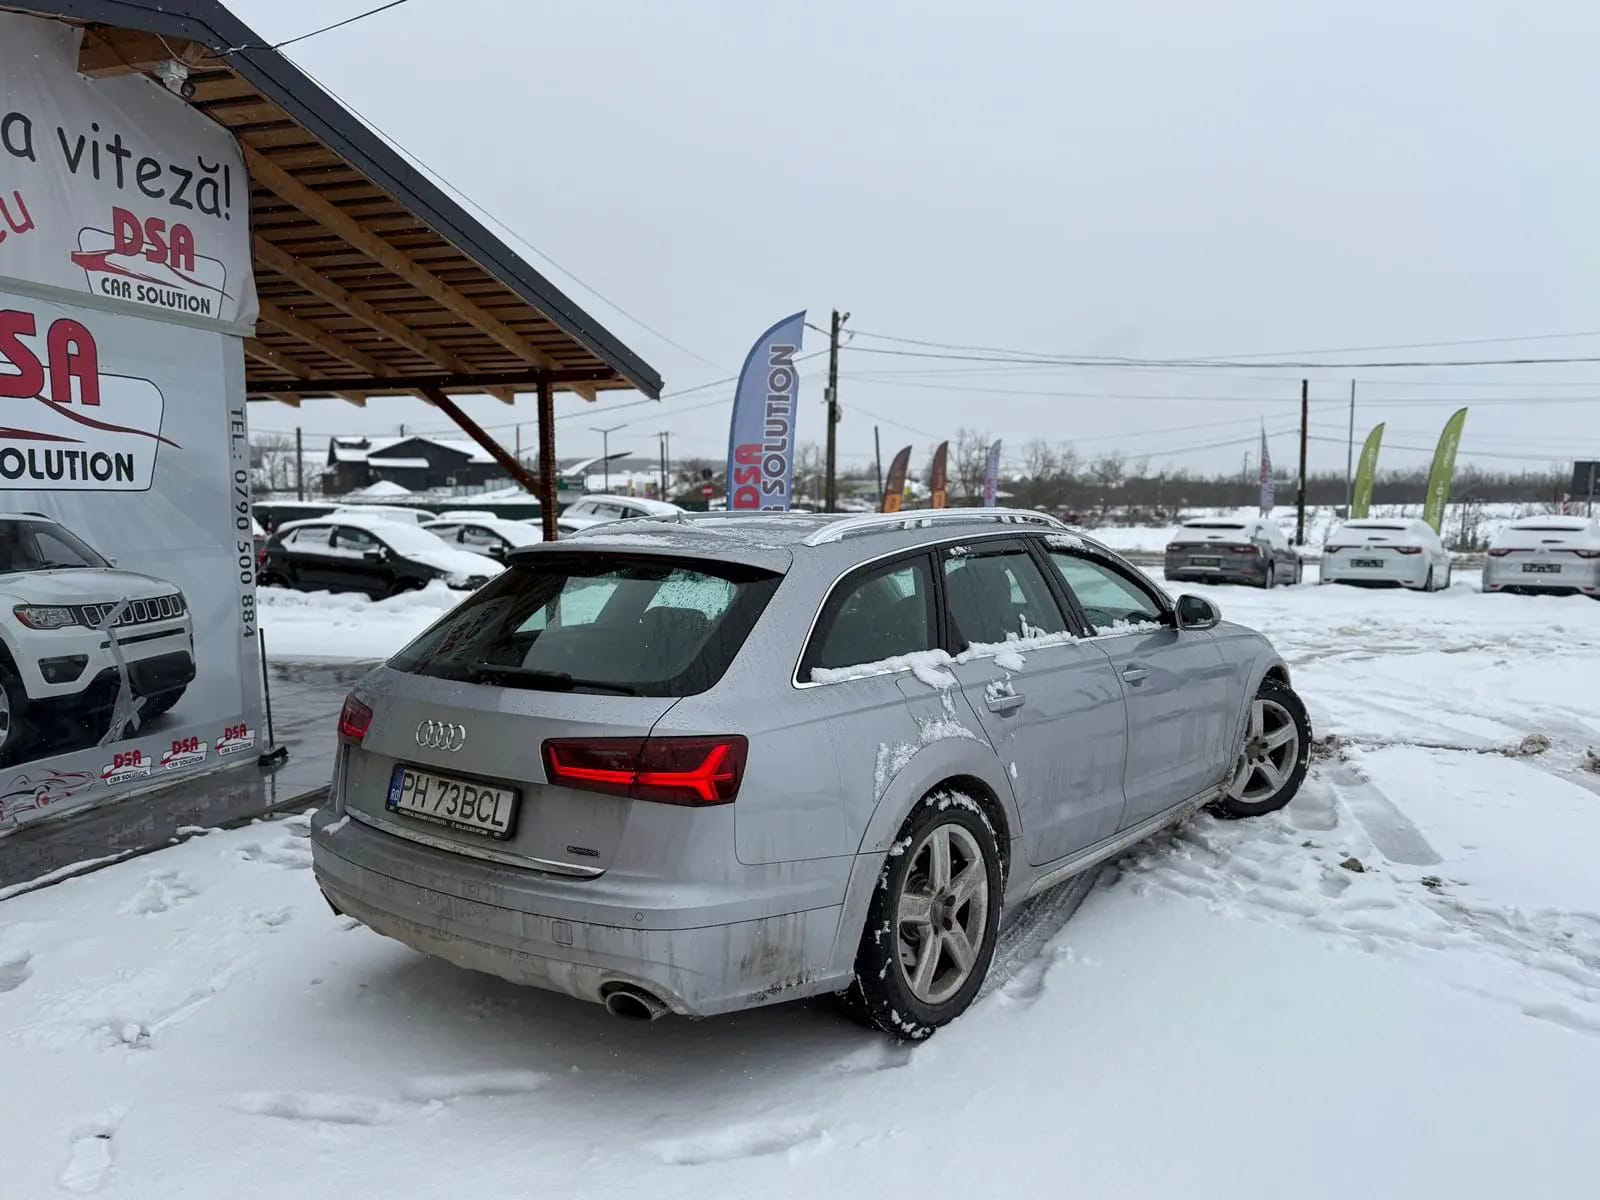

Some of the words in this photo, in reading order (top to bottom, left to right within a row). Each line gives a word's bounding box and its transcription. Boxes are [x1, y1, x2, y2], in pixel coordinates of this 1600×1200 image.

[57, 123, 230, 221] viteză!
[112, 206, 195, 273] DSA
[101, 277, 132, 299] CAR
[137, 285, 211, 315] SOLUTION
[0, 309, 100, 406] SA
[762, 344, 796, 496] SOLUTION
[0, 447, 134, 482] OLUTION
[734, 444, 763, 509] DSA
[234, 469, 250, 531] 0790
[237, 541, 252, 585] 500
[241, 594, 255, 638] 884
[171, 736, 199, 755] DSA
[224, 723, 248, 741] DSA
[109, 775, 121, 784] CAR
[121, 770, 149, 781] SOLUTION
[113, 749, 142, 769] DSA
[168, 761, 179, 769] CAR
[179, 755, 204, 766] SOLUTION
